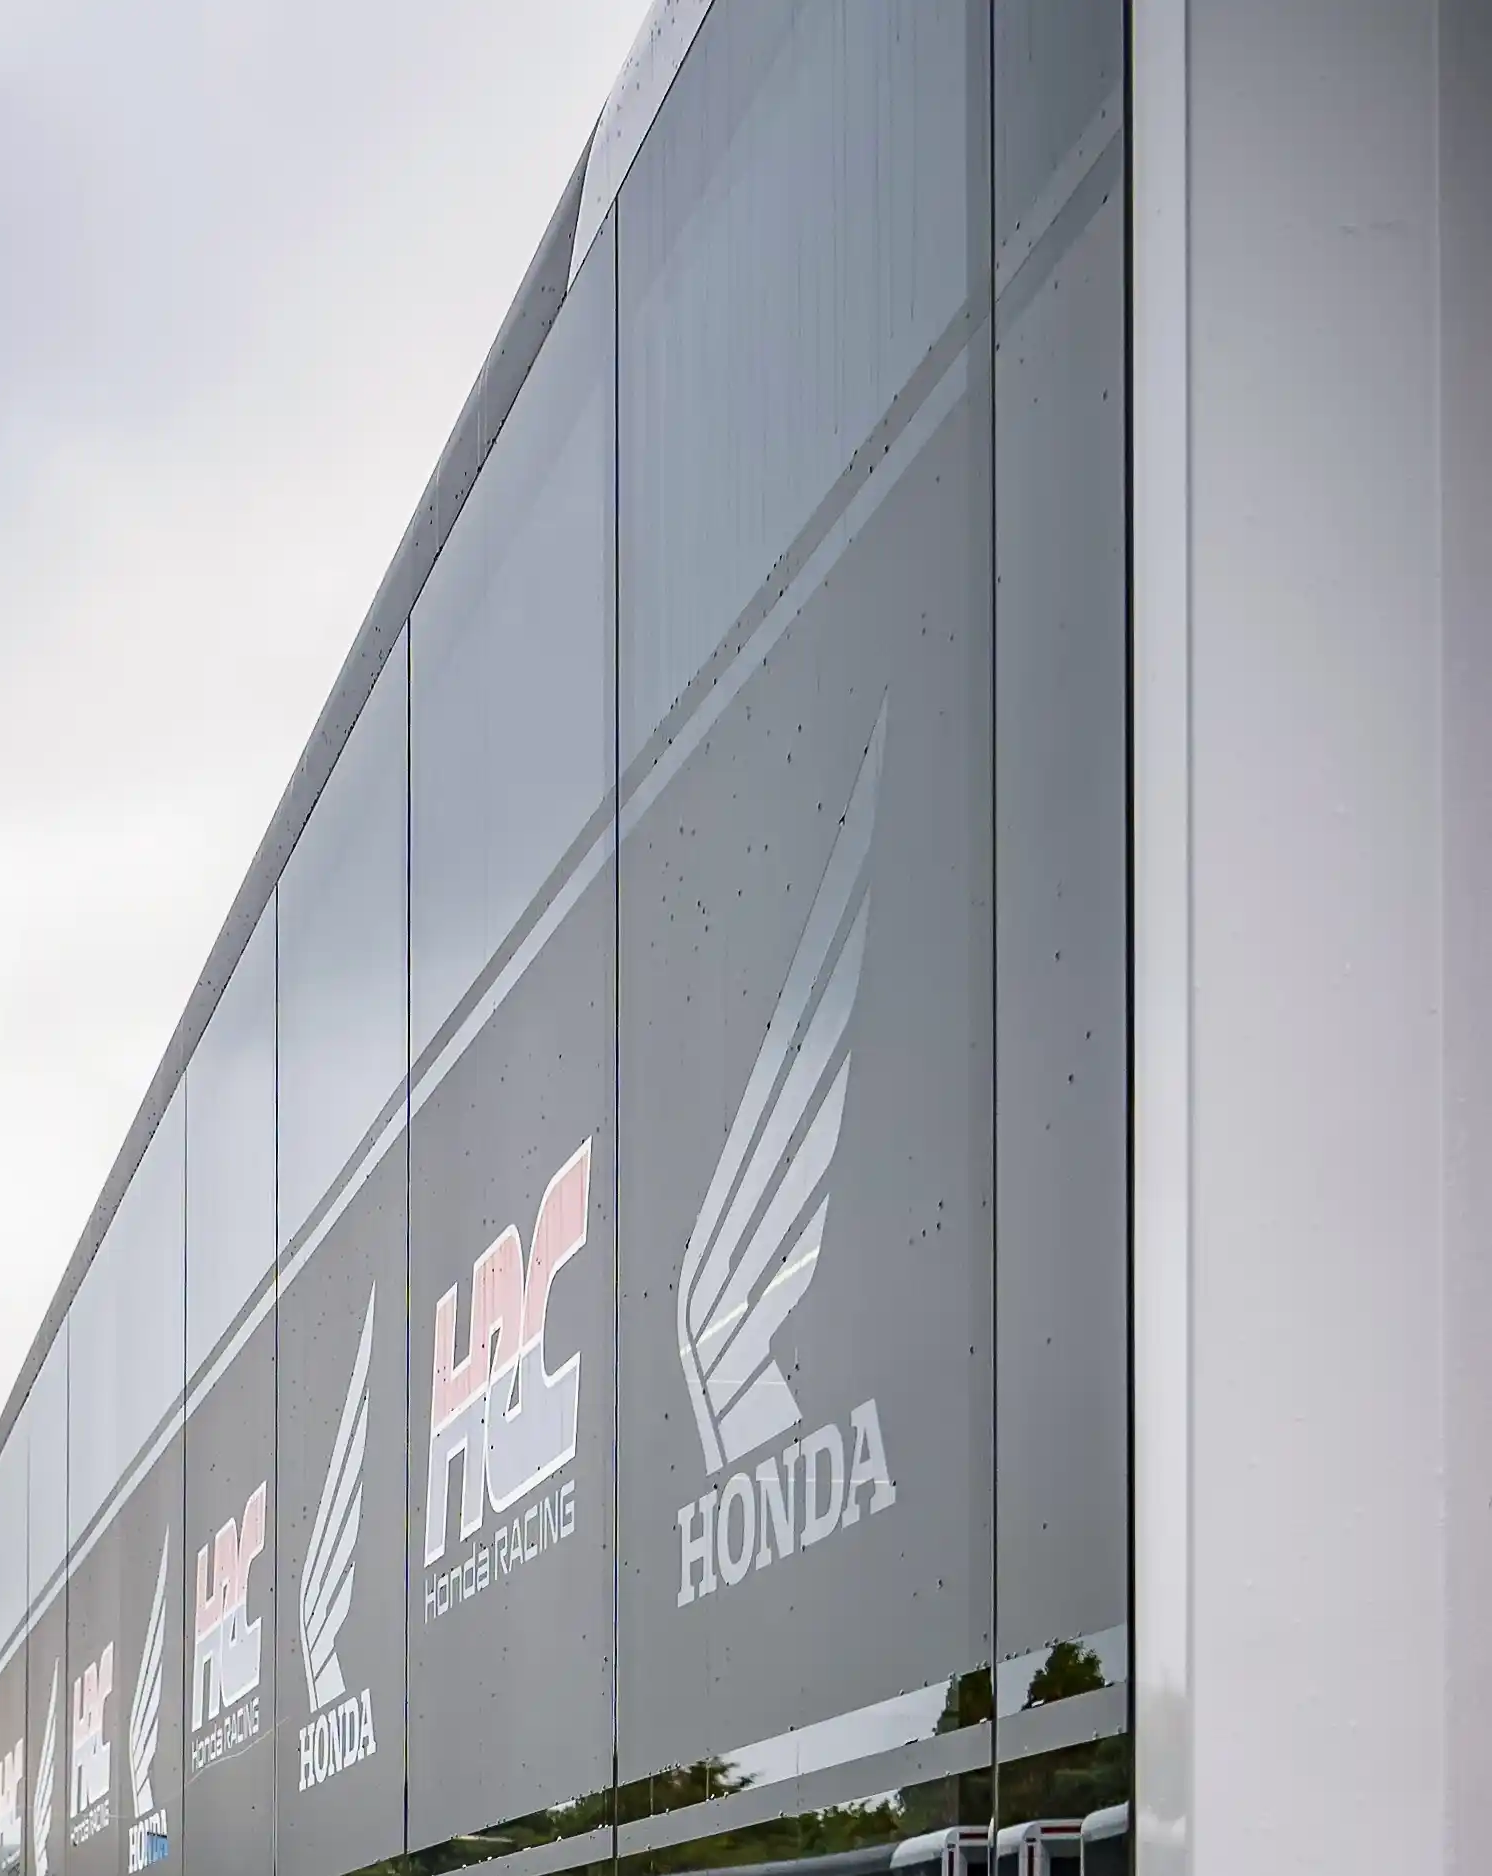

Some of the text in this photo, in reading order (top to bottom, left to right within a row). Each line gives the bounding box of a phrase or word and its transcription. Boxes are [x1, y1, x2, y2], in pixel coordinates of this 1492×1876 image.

[423, 1136, 593, 1569] HRC
[424, 1479, 575, 1625] Honda RACING
[676, 1398, 897, 1608] HONDA
[298, 1688, 377, 1792] HONDA
[128, 1809, 169, 1874] HONDA
